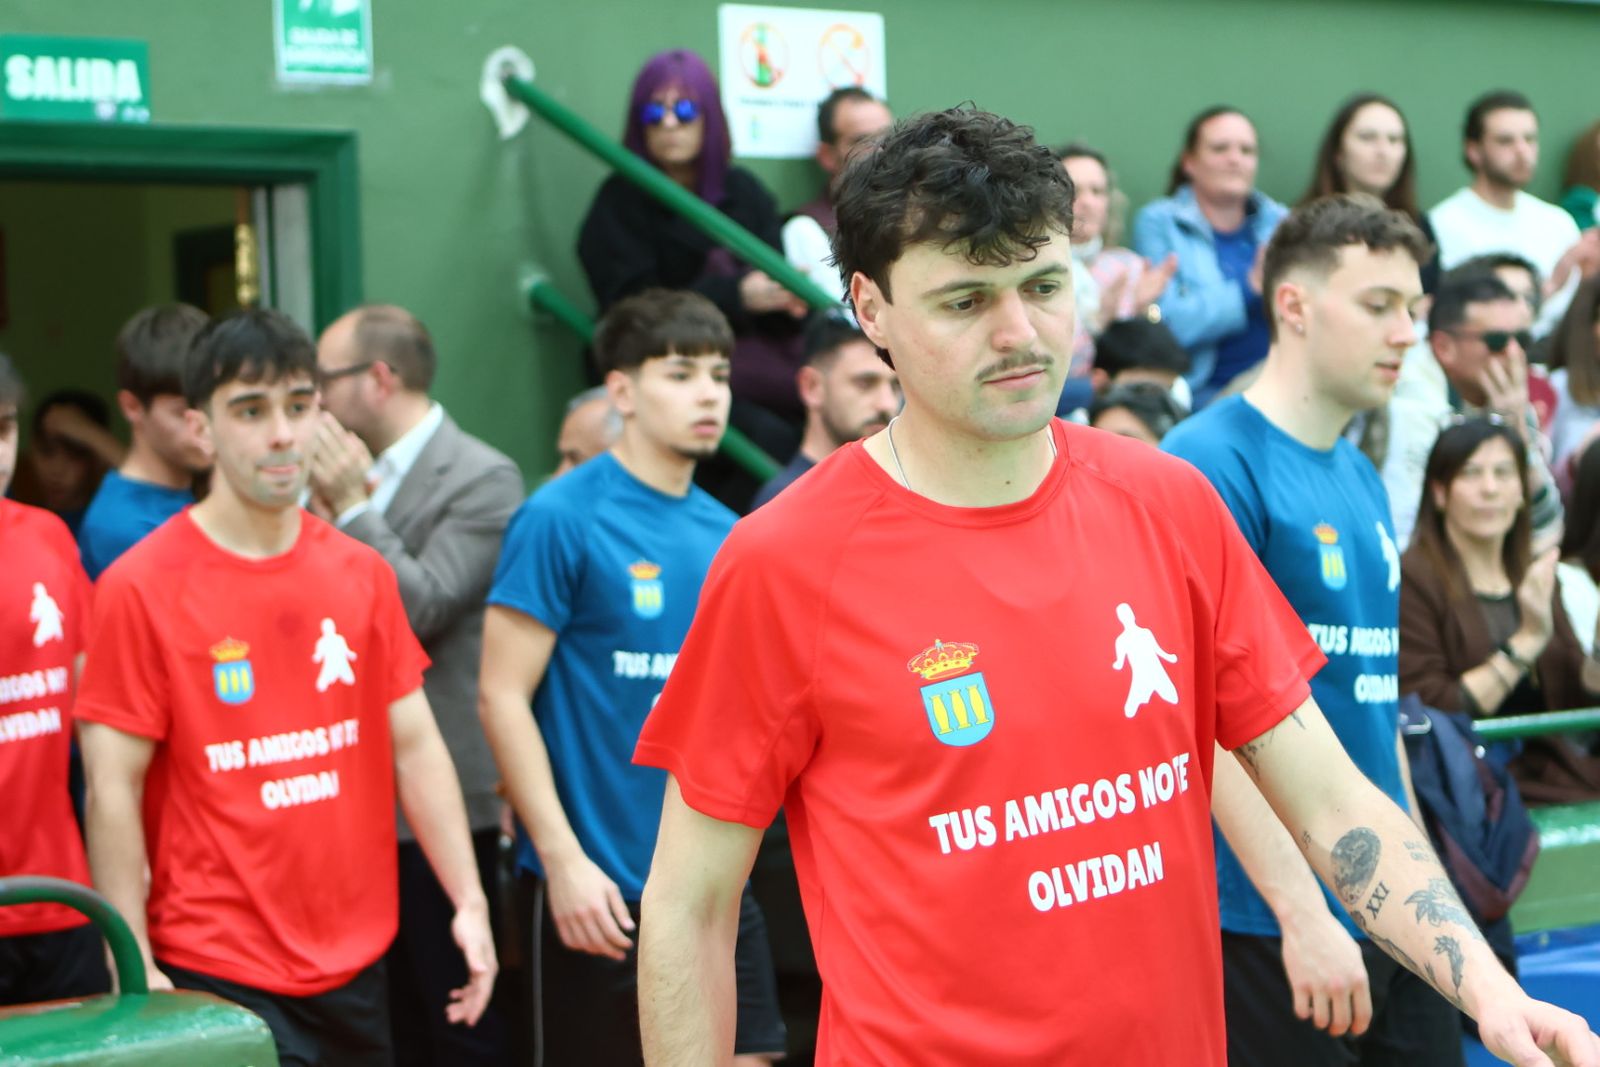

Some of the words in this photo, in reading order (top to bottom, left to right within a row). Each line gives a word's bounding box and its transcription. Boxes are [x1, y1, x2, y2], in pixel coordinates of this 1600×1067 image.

[5, 54, 142, 103] SALIDA
[1307, 623, 1348, 656] TUS
[613, 651, 650, 678] TUS
[0, 669, 46, 704] IGOS
[0, 707, 62, 744] VIDAN
[205, 741, 246, 773] TUS
[248, 726, 330, 768] AMIGOS
[928, 805, 997, 855] TUS
[1004, 773, 1137, 842] AMIGOS
[1138, 762, 1175, 809] NO
[1028, 841, 1164, 912] OLVIDAN
[1366, 881, 1390, 920] XXI
